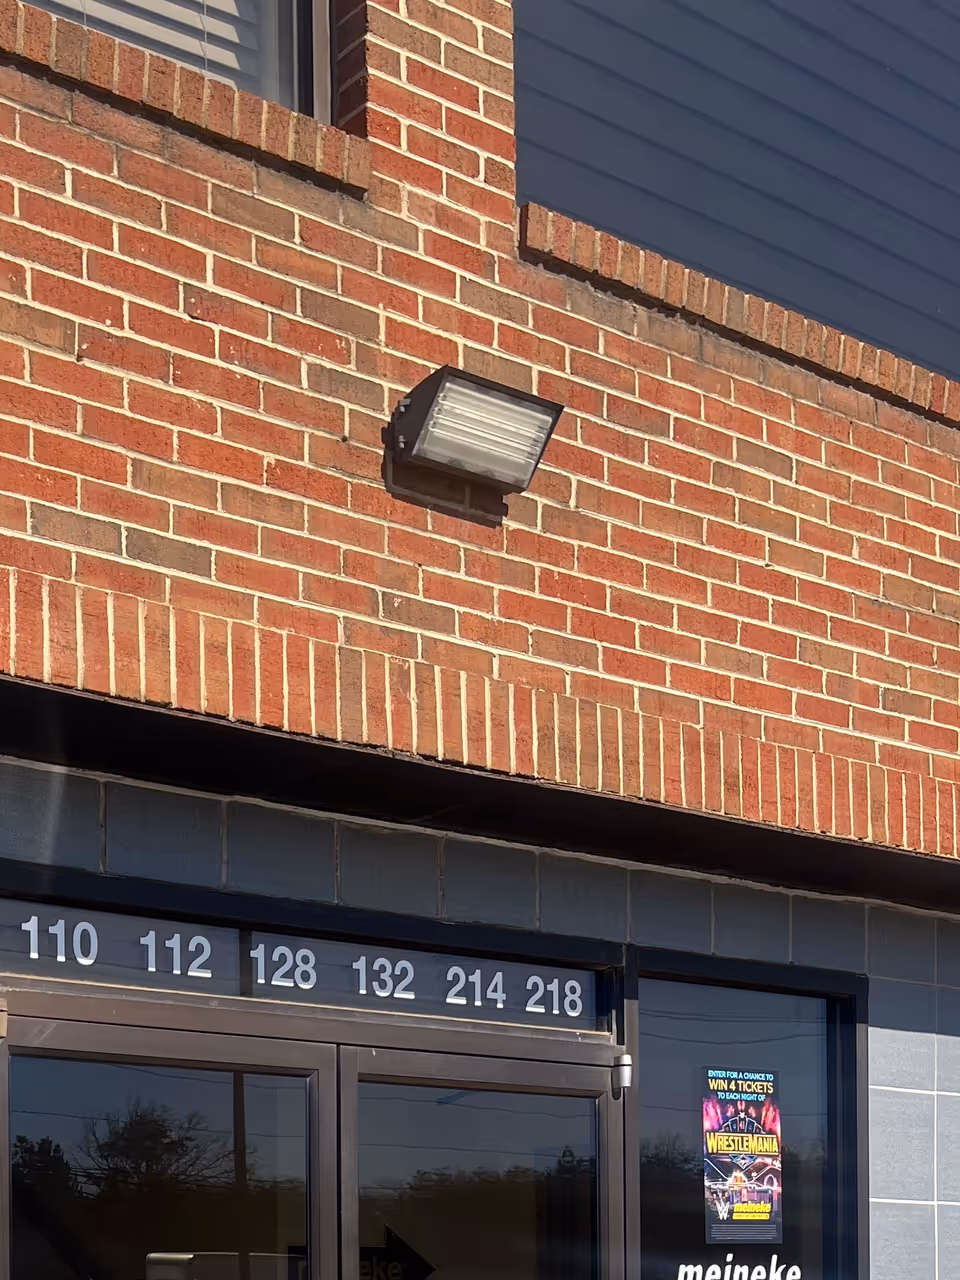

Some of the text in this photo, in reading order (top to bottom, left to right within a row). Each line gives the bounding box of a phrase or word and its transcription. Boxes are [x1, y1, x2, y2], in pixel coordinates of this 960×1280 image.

[21, 916, 583, 1017] 110 112 128 132 214 218
[707, 1069, 726, 1078] ENTER
[727, 1070, 738, 1079] FOR
[738, 1072, 744, 1080] A
[744, 1073, 765, 1081] CHANCE
[708, 1079, 774, 1094] WIN 4 TICKETS
[717, 1092, 725, 1100] TO
[726, 1092, 740, 1100] EACH
[741, 1093, 756, 1101] NIGHT
